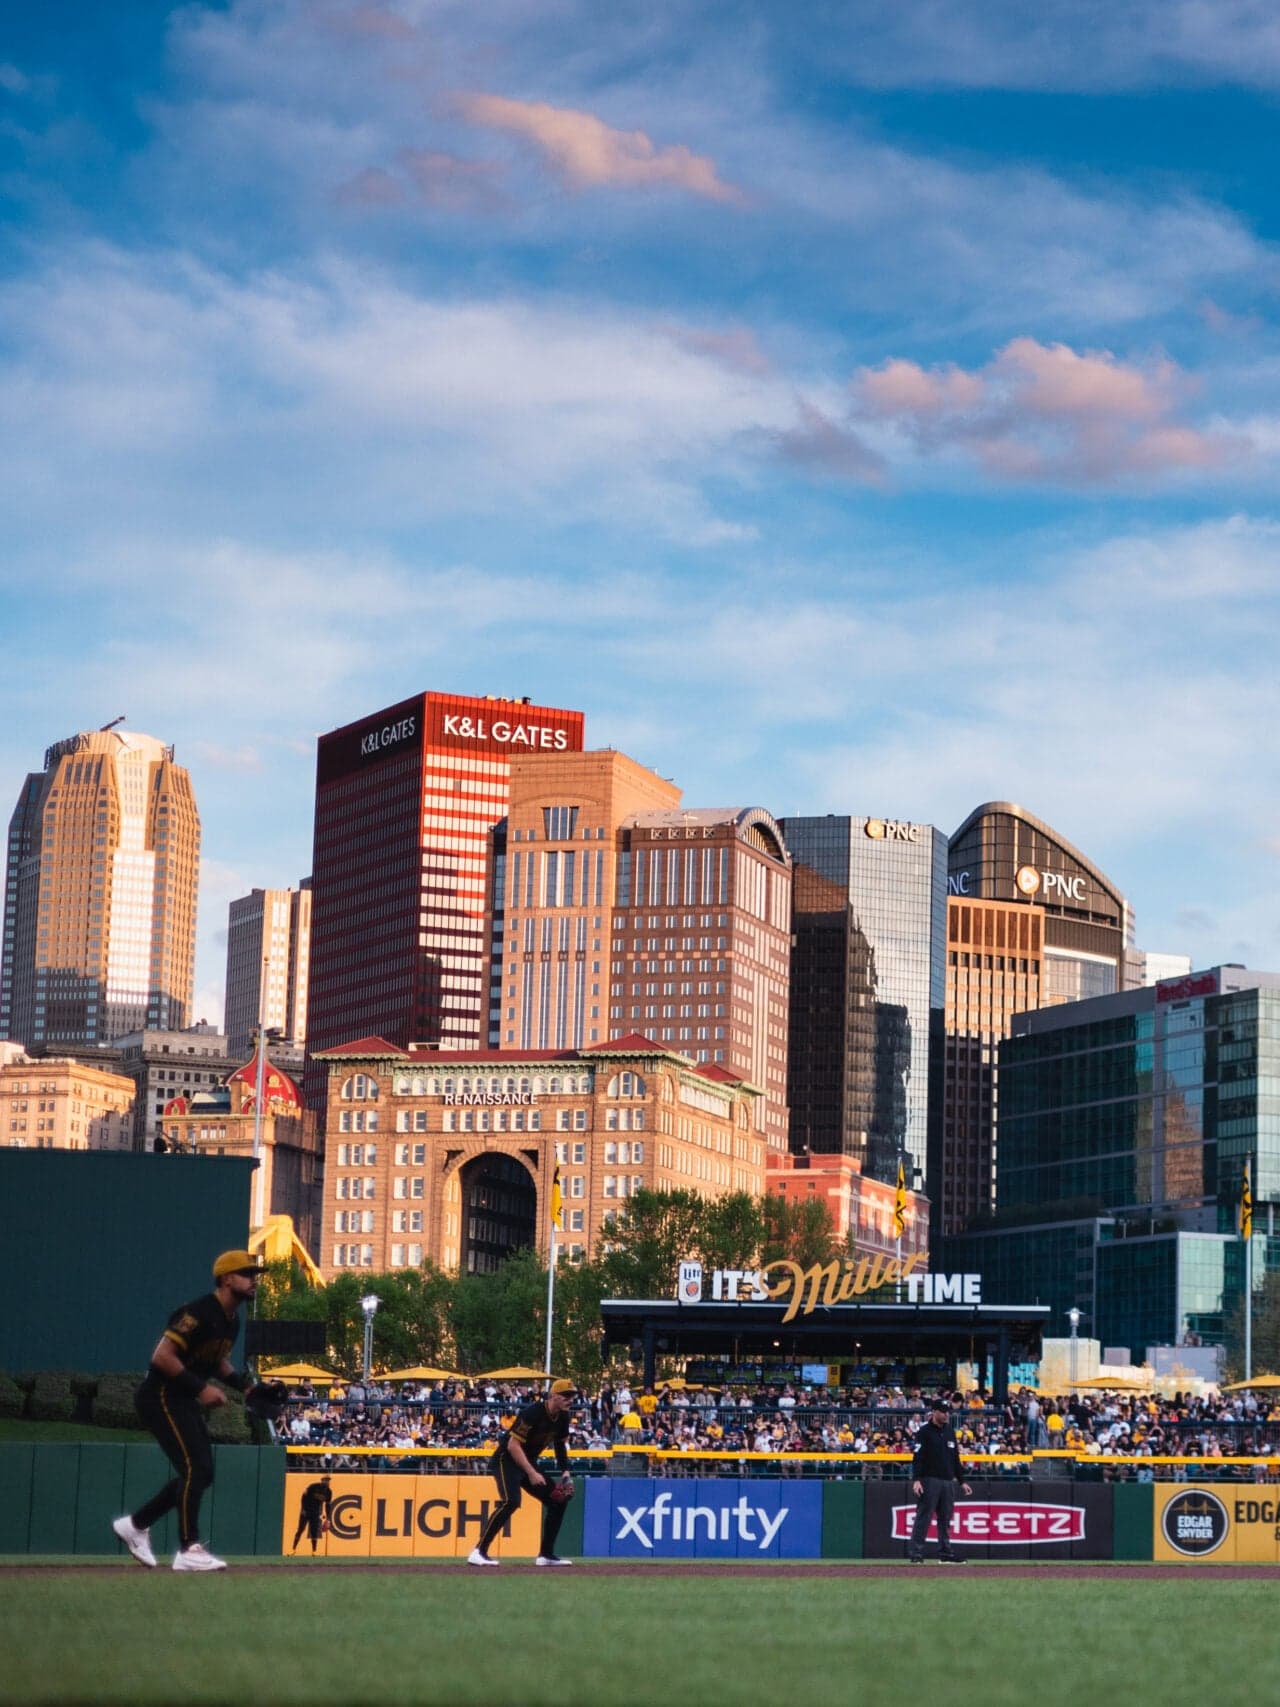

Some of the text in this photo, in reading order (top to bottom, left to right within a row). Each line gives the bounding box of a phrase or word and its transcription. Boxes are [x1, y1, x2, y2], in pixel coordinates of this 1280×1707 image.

[361, 716, 416, 755] K&L GATES
[444, 714, 568, 750] K&L GATES
[885, 823, 920, 842] PNC
[948, 871, 970, 895] NC
[1042, 871, 1086, 900] PNC
[444, 1093, 539, 1105] RENAISSANCE
[712, 1252, 981, 1323] IT'S Miller TIME
[615, 1492, 790, 1549] xfinity
[1177, 1515, 1213, 1528] EDGAR
[1177, 1528, 1214, 1539] SNYDER
